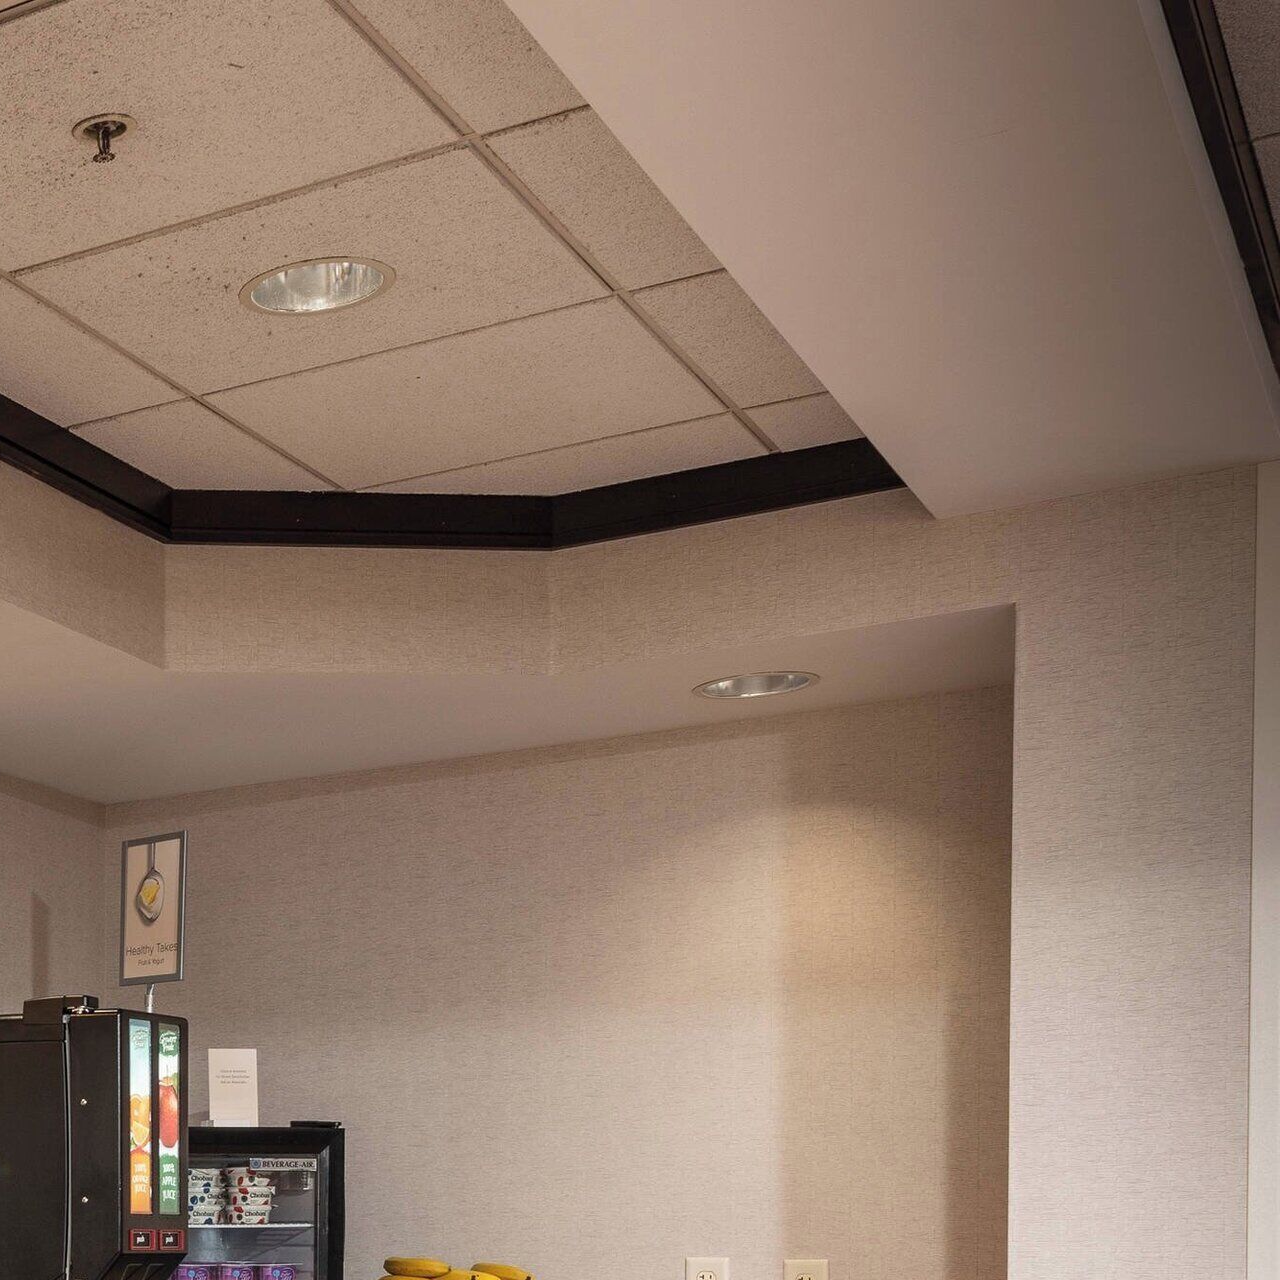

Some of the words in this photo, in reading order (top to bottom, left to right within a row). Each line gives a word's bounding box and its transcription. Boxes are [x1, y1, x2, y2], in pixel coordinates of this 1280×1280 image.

[156, 942, 178, 953] Takes
[162, 1175, 176, 1186] APPLE
[162, 1189, 176, 1201] JUICE
